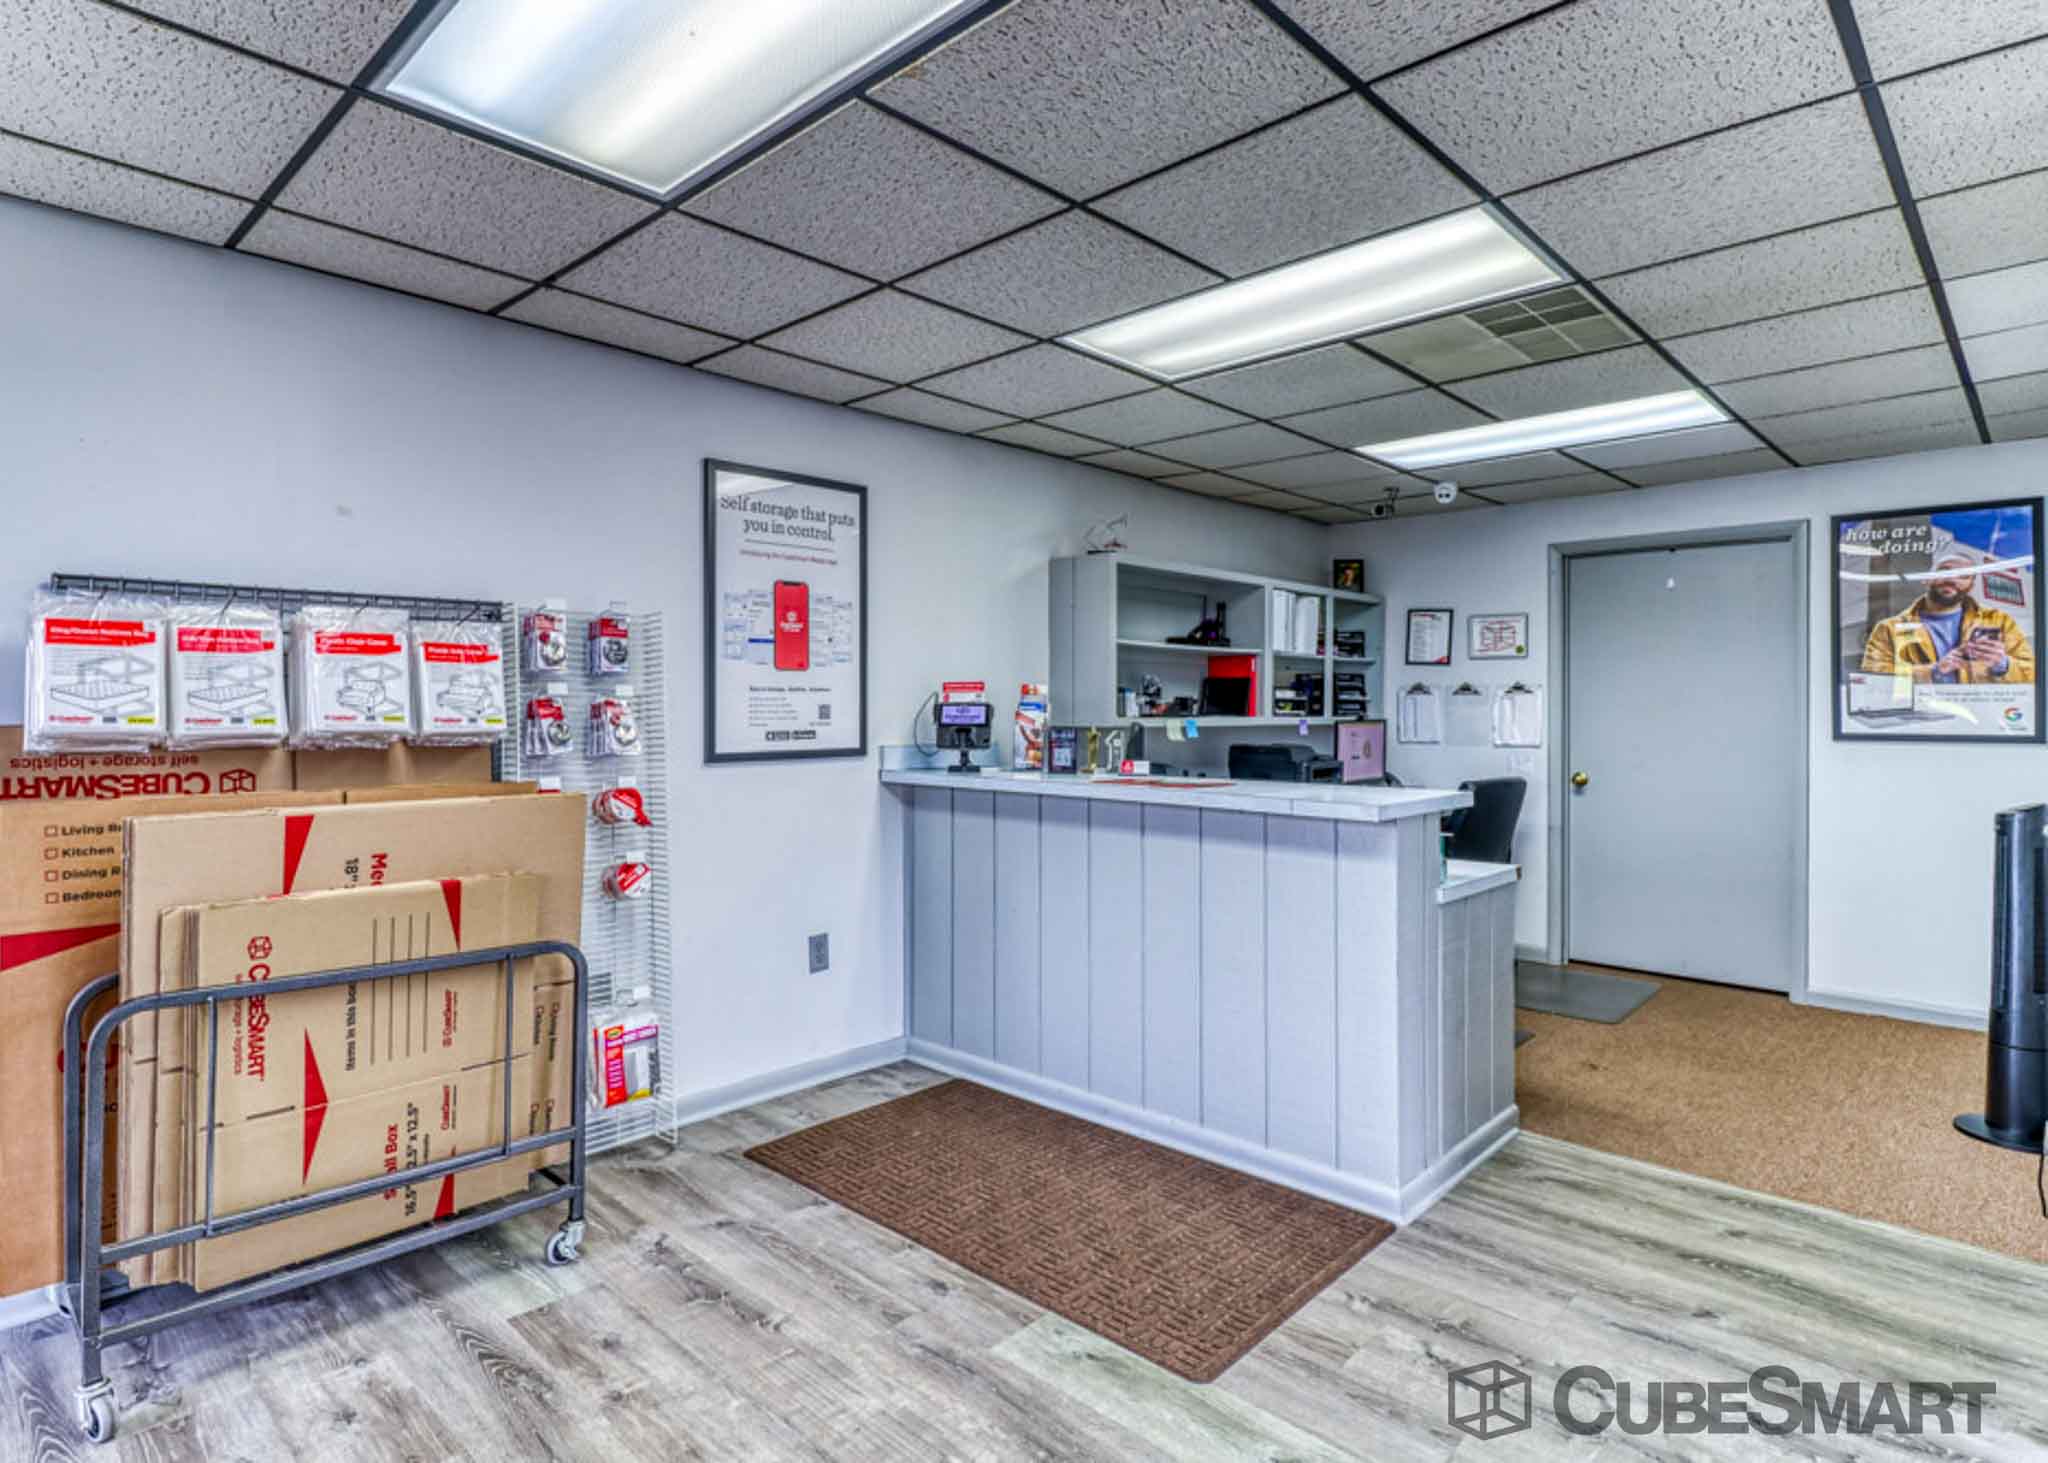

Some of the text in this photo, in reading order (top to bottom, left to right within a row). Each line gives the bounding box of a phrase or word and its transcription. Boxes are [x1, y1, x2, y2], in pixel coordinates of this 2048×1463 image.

[720, 495, 855, 527] Self storage that puts
[743, 518, 769, 534] you
[771, 520, 785, 535] in
[1845, 525, 1928, 542] how are
[10, 756, 85, 770] logistics
[102, 753, 165, 769] storage
[166, 753, 199, 766] self
[62, 824, 104, 836] Living
[62, 846, 115, 858] Kitchen
[62, 868, 108, 881] Dining
[384, 1123, 399, 1200] Sall Box
